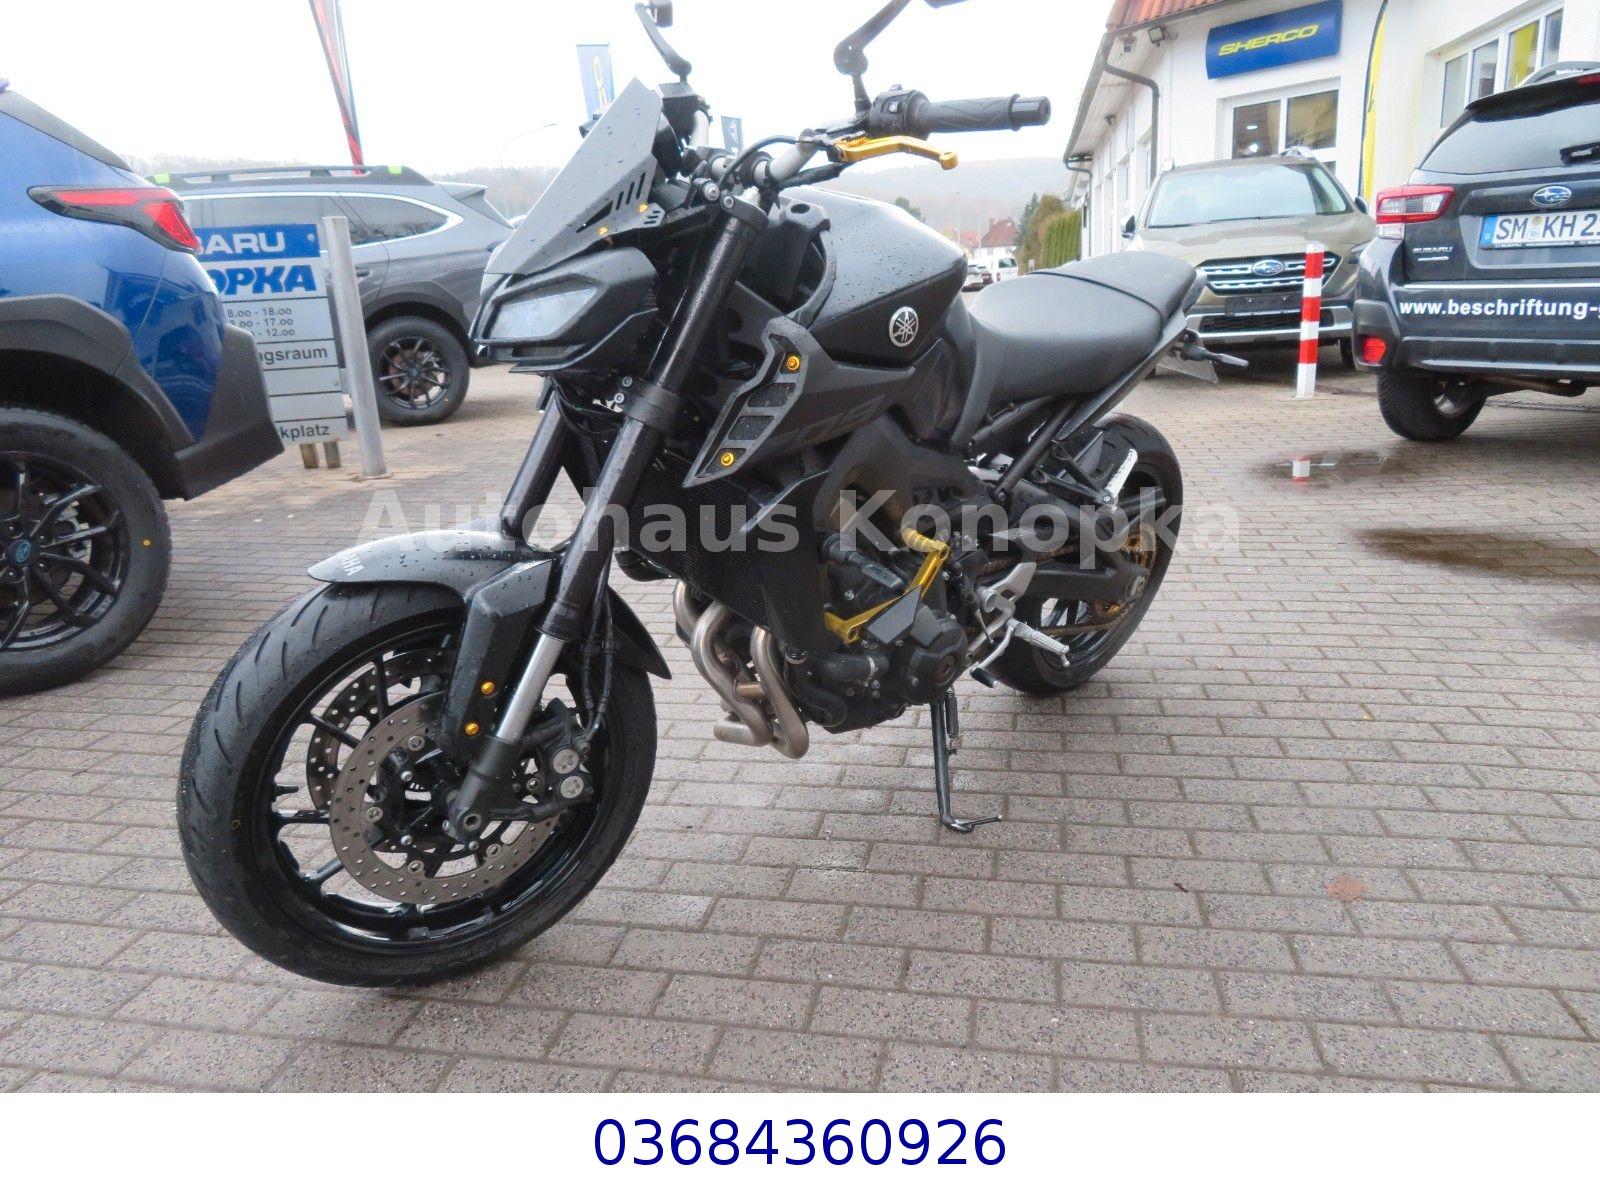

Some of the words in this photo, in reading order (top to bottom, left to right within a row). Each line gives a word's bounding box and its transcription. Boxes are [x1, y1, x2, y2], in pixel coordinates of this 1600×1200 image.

[1218, 24, 1319, 56] SHERCO
[1496, 218, 1528, 240] SM
[1542, 214, 1577, 238] KH
[1580, 213, 1600, 237] 2
[263, 307, 292, 316] 18.00
[265, 318, 293, 327] 17.00
[266, 329, 295, 338] 12.00
